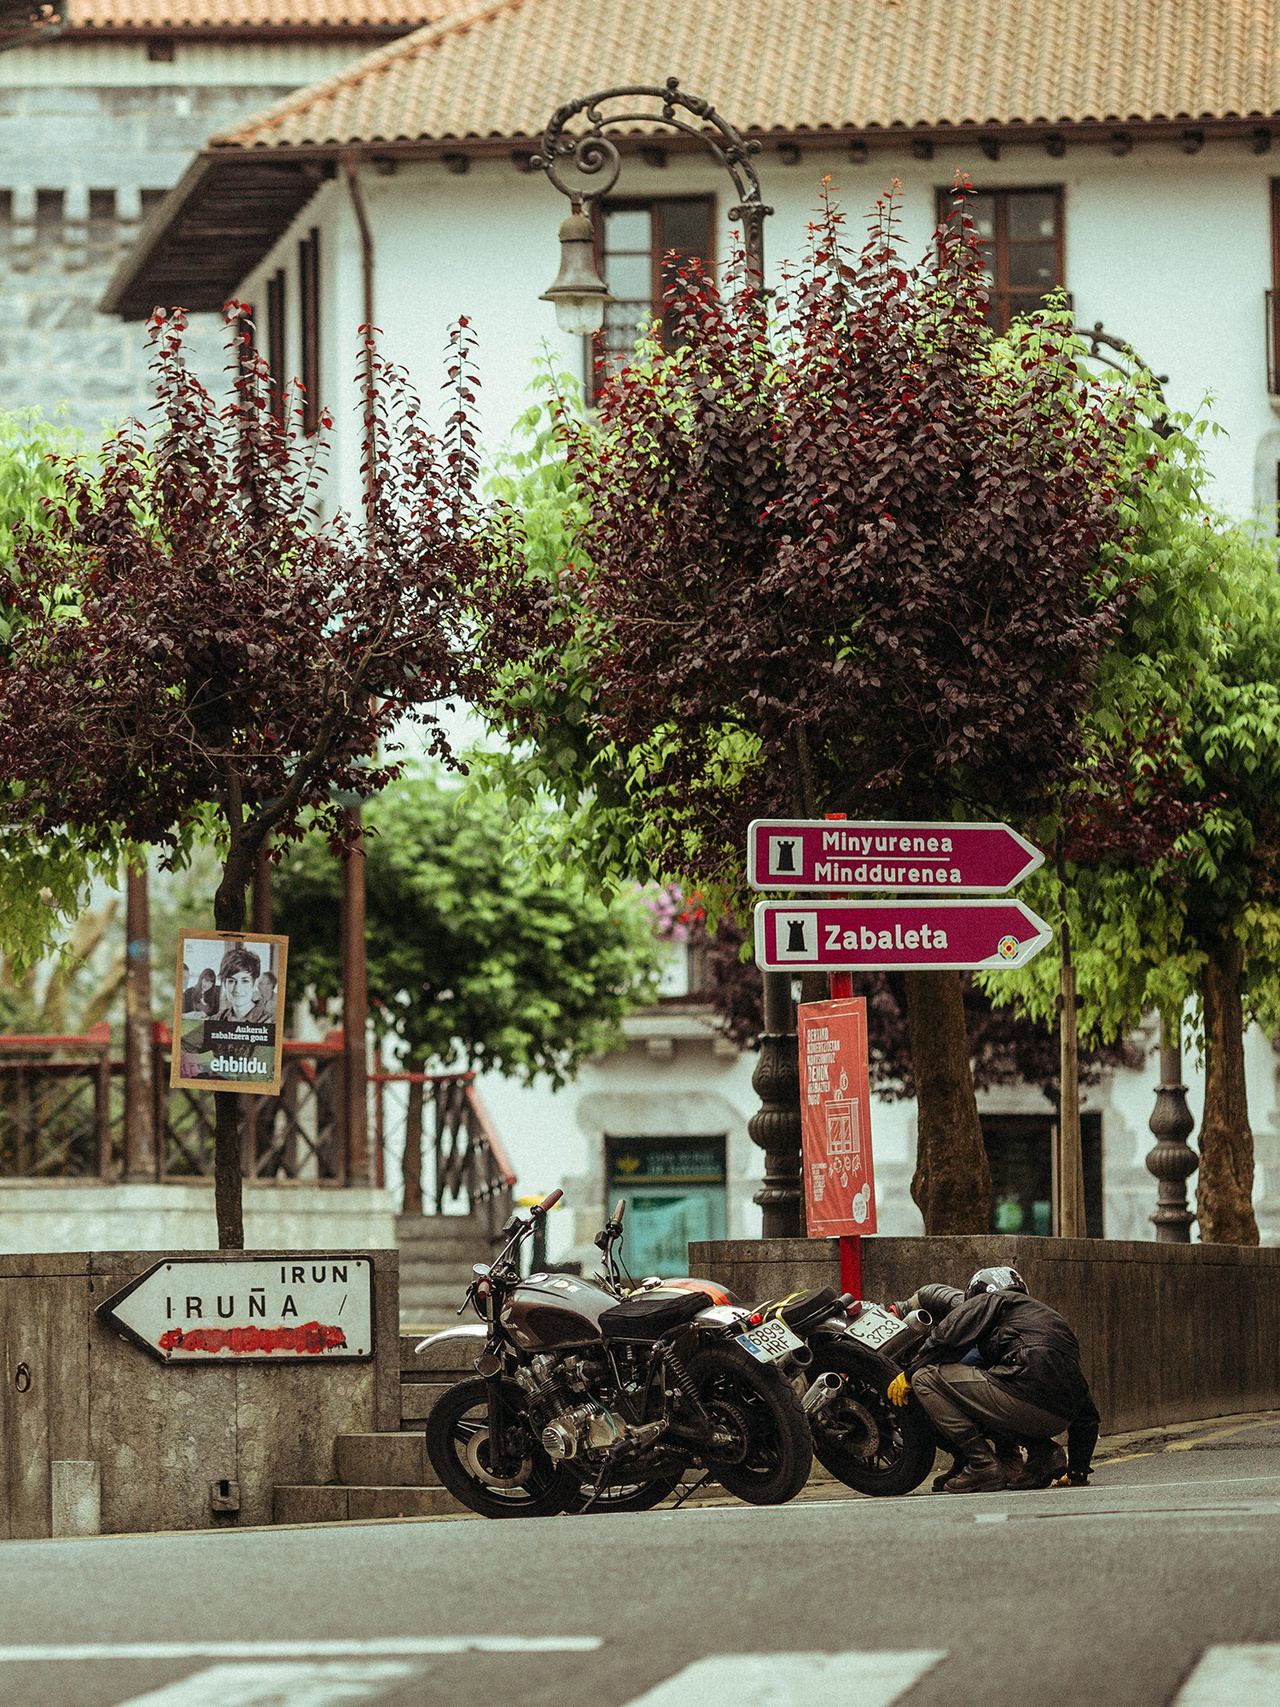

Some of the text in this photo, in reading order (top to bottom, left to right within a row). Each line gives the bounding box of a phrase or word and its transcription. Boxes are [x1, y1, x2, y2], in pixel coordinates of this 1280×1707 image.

[822, 831, 953, 855] Minyurenea
[814, 862, 962, 884] Minddurenea
[825, 924, 949, 951] Zabaleta
[211, 1032, 269, 1043] zabaltzera goaz
[235, 1025, 269, 1035] Aukerak
[210, 1055, 268, 1075] ehbildu
[280, 1265, 349, 1284] IRUN
[166, 1287, 299, 1319] IRUÑA
[748, 1323, 786, 1346] 6899
[866, 1320, 901, 1344] 3733
[761, 1335, 790, 1356] HRF
